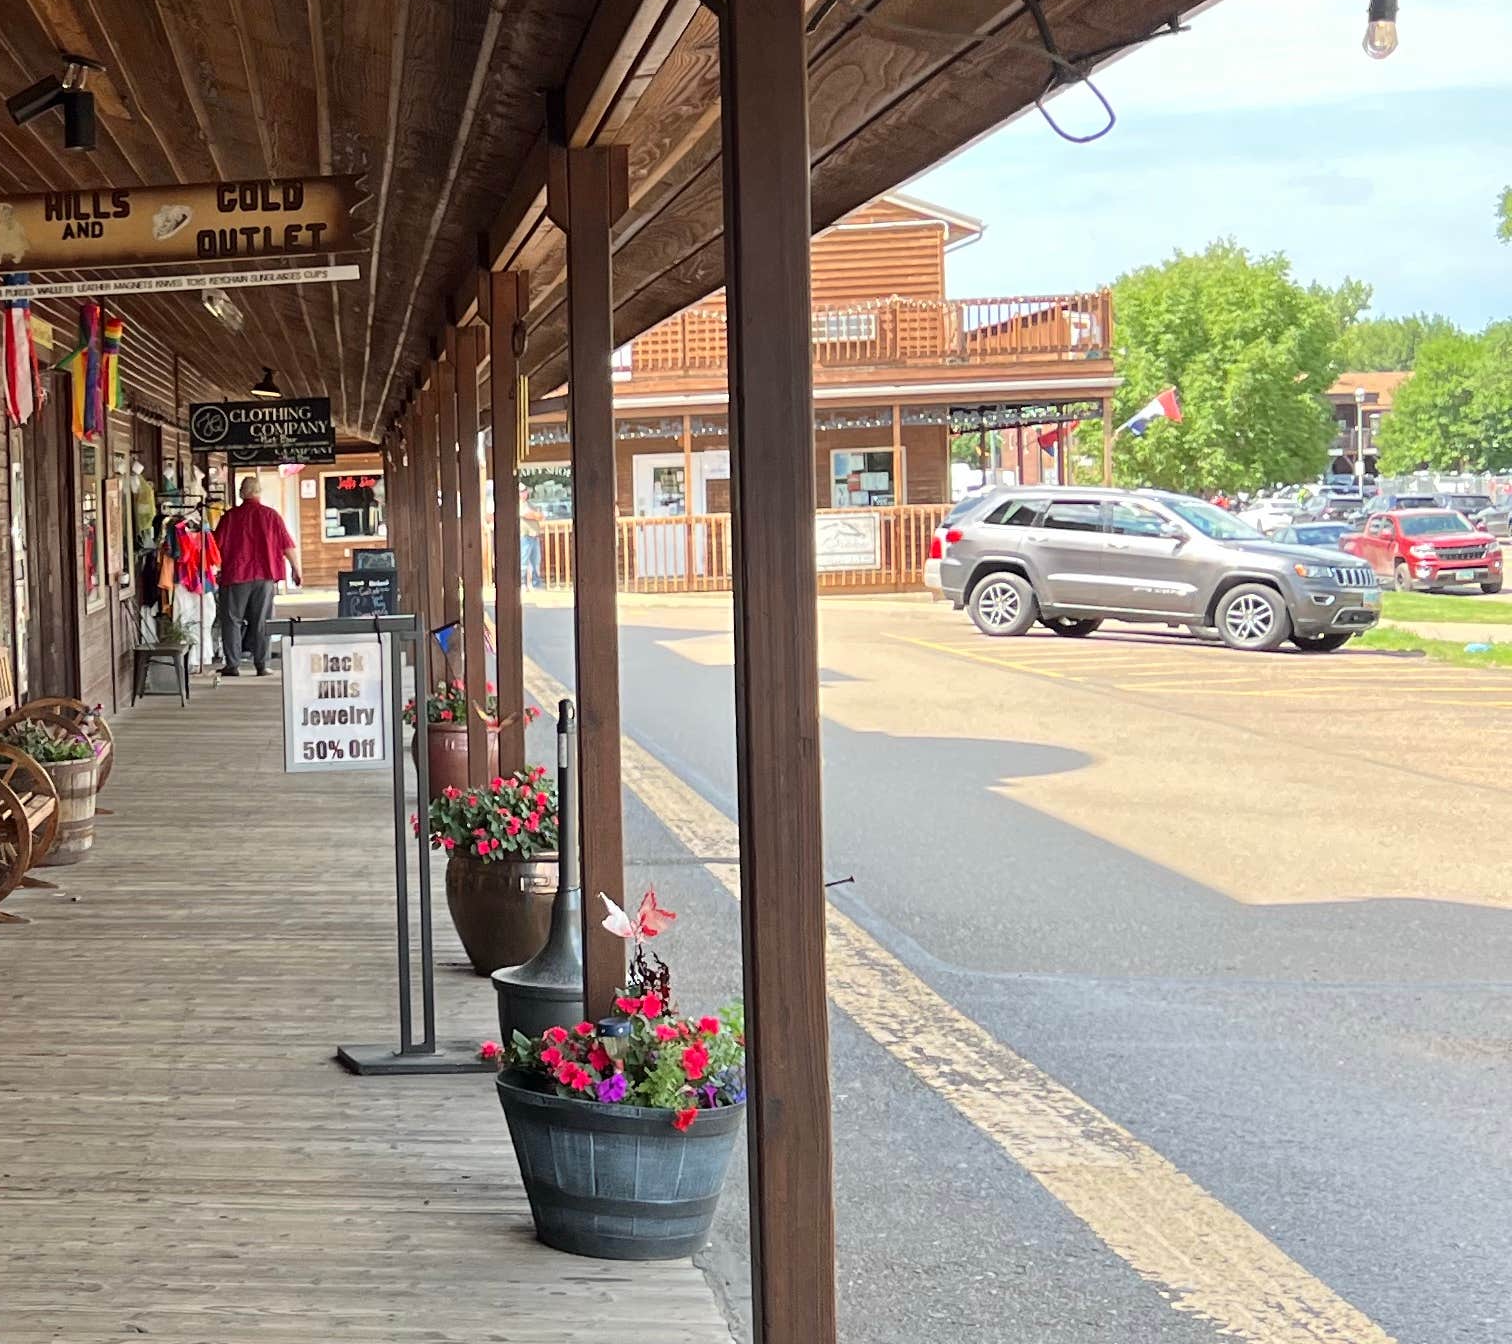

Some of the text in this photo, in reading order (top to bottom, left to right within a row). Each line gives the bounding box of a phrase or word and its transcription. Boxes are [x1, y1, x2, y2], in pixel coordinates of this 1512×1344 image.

[44, 190, 131, 222] HILLS
[216, 181, 305, 213] GOLD
[61, 221, 105, 241] AND
[196, 222, 328, 257] OUTLET
[38, 284, 74, 295] WALLETS
[77, 282, 111, 293] LEATHER
[114, 281, 153, 291] MAGNETS
[155, 279, 183, 288] KNIVES
[187, 277, 206, 287] TOYS
[209, 275, 248, 285] KEYCHAIN
[250, 271, 301, 283] SUNGLASSES
[229, 406, 312, 423] CLOTHING
[249, 420, 328, 437] COMPANY
[310, 652, 364, 674] Black
[318, 680, 361, 699] Hills
[301, 705, 375, 727] Jewelry
[303, 739, 376, 760] 50% Off
